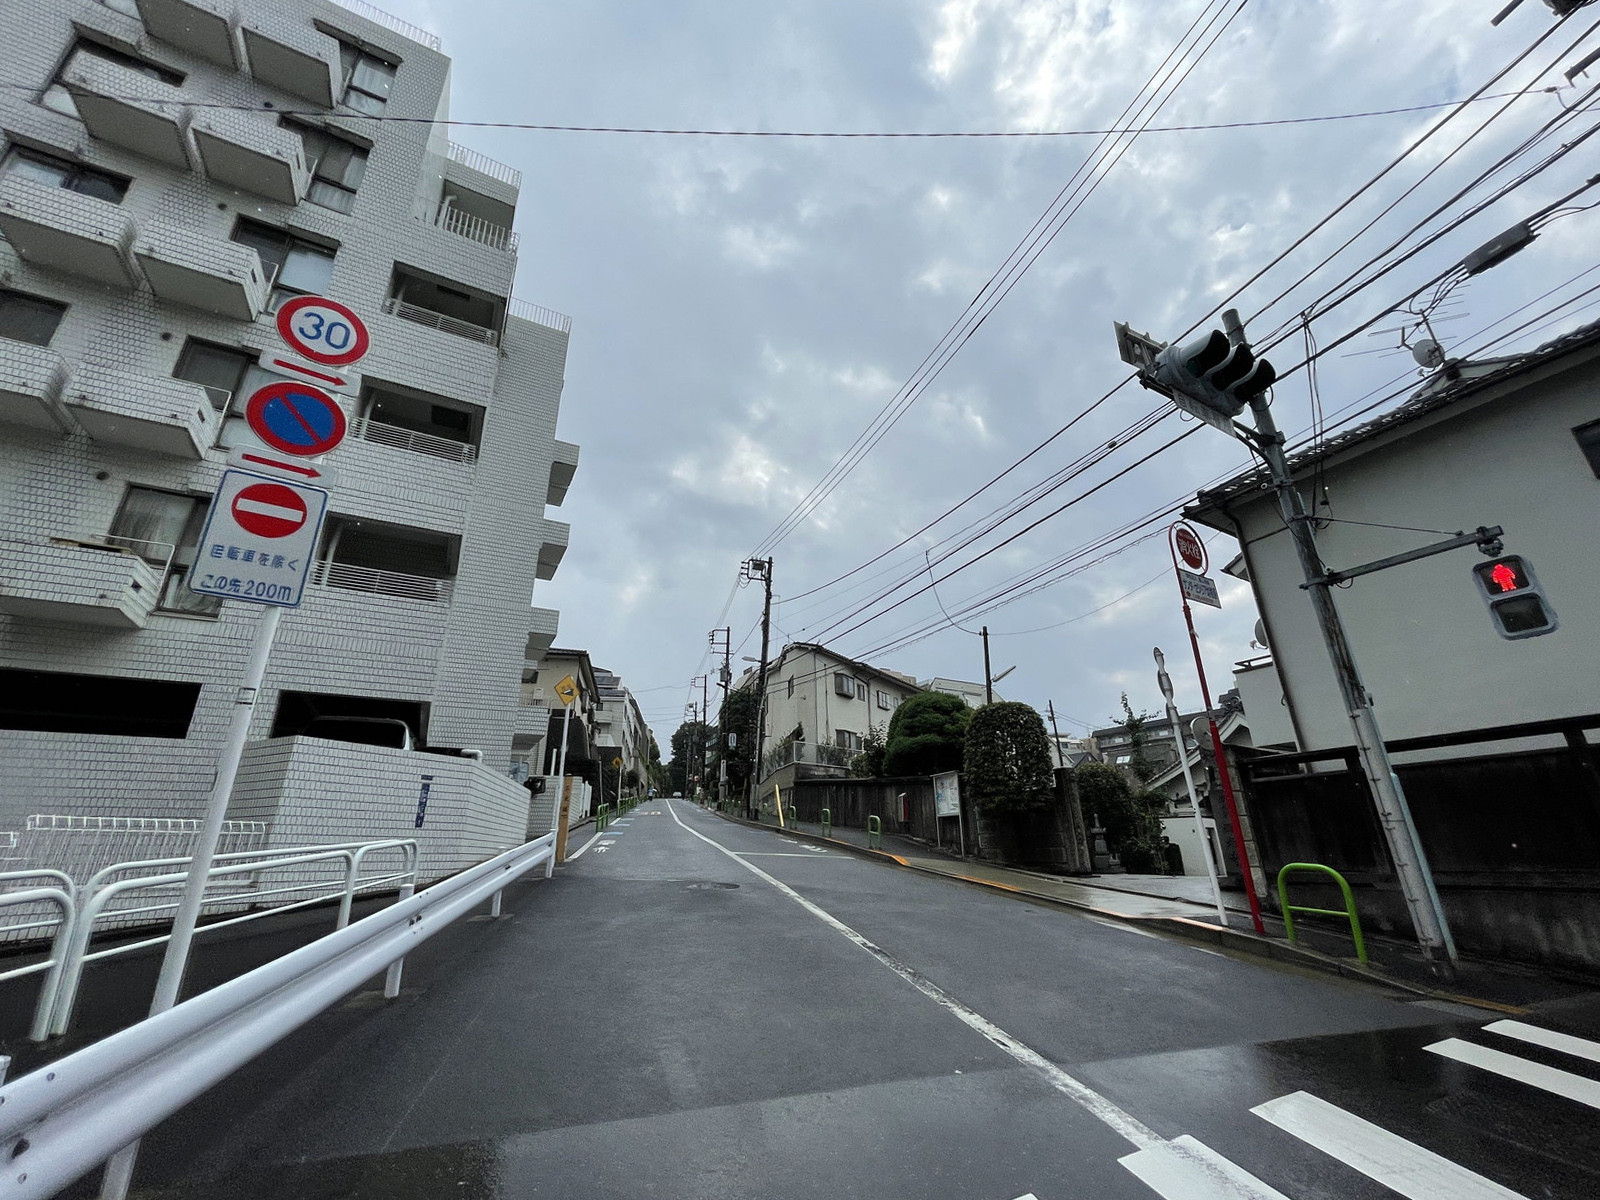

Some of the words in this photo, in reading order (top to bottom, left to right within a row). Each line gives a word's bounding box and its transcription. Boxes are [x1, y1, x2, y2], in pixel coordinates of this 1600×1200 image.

[299, 312, 350, 349] 30
[210, 544, 299, 572] 自転車を除く
